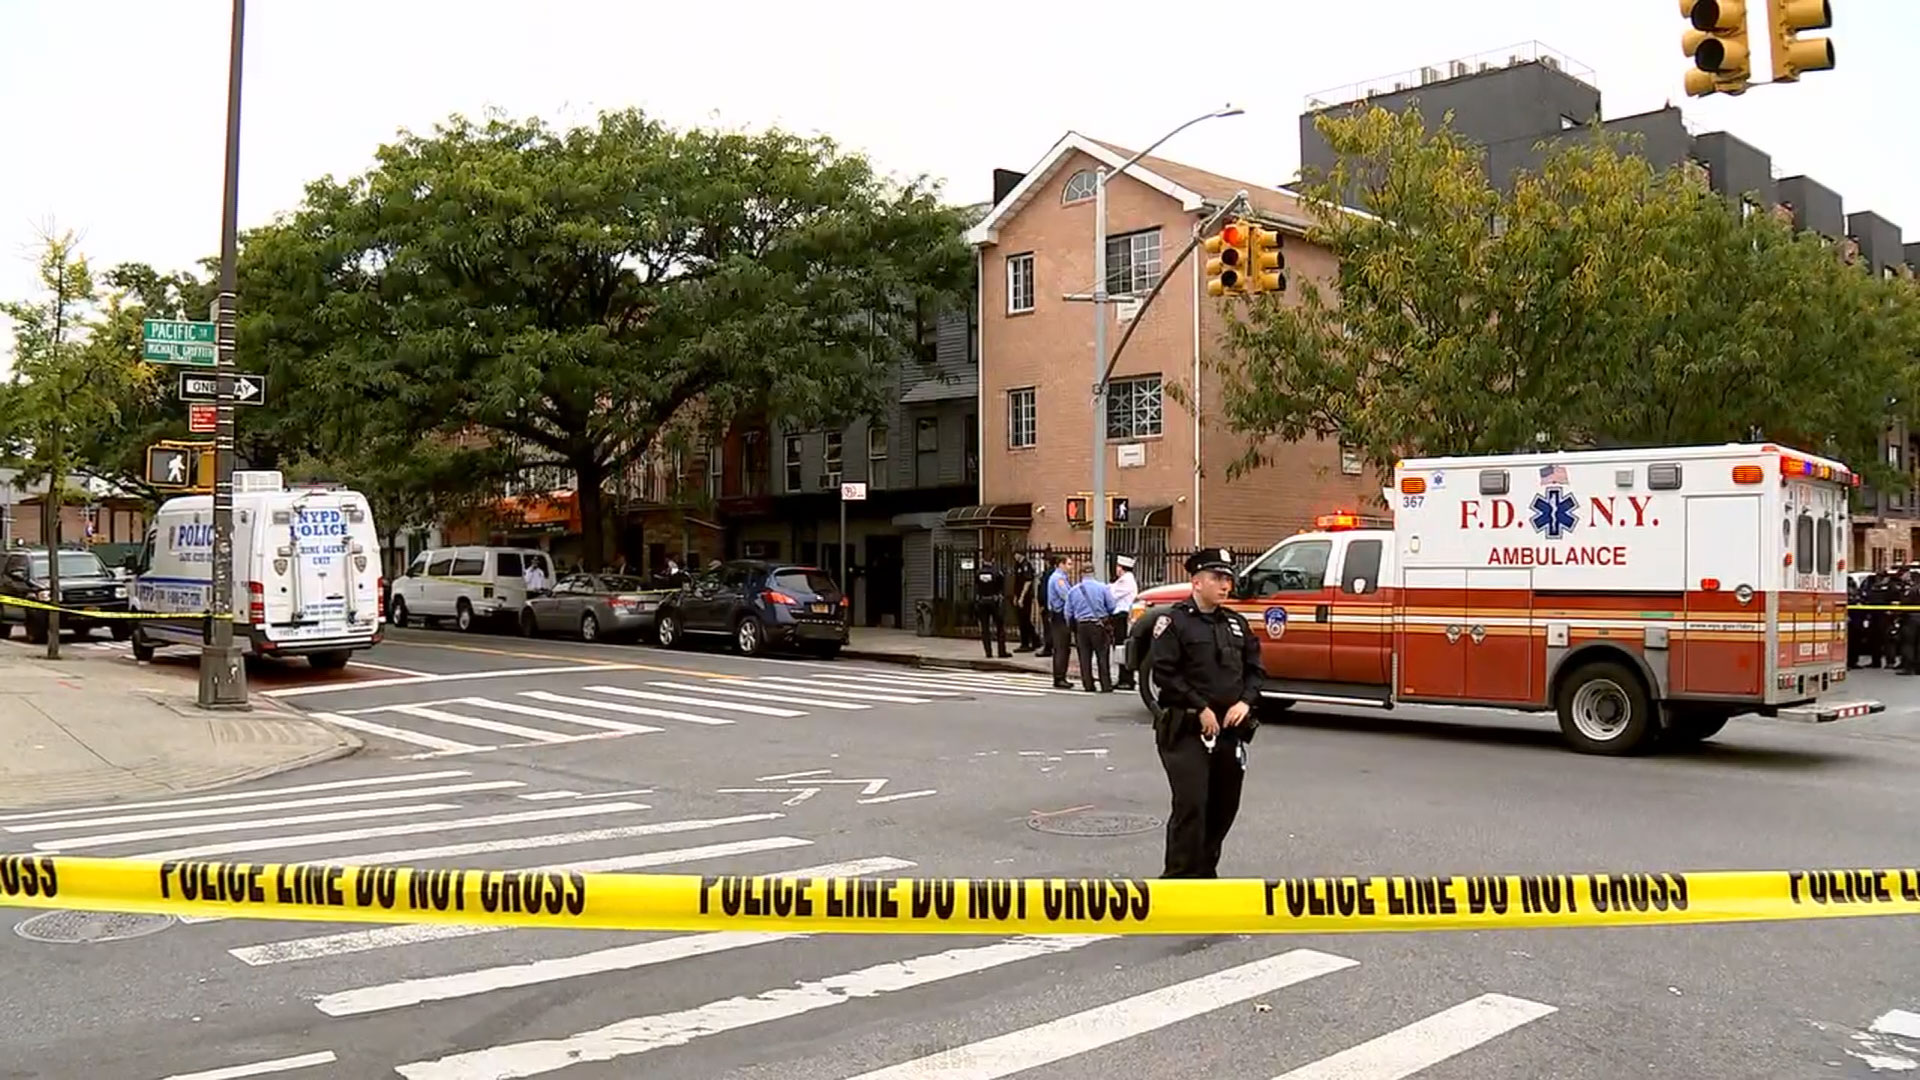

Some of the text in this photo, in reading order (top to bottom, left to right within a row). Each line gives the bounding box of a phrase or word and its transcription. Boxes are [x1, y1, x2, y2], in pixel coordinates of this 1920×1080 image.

[150, 322, 196, 340] PACIFIC
[147, 343, 178, 355] MICHAEL
[192, 382, 251, 394] ONE AY
[1402, 495, 1425, 508] 367
[299, 510, 340, 523] NYPD
[1460, 496, 1659, 529] F.D. N.Y.
[178, 525, 214, 546] POLIC
[1487, 546, 1627, 566] AMBULANCE
[0, 857, 58, 898] OSS
[160, 861, 585, 915] POLICE LINE DO NOT CROSS
[1789, 869, 1920, 904] POLICE L
[698, 877, 1150, 921] POLICE LINE DO NOT CROSS
[1265, 872, 1689, 916] POLICE LINE DO NOT CROSS
